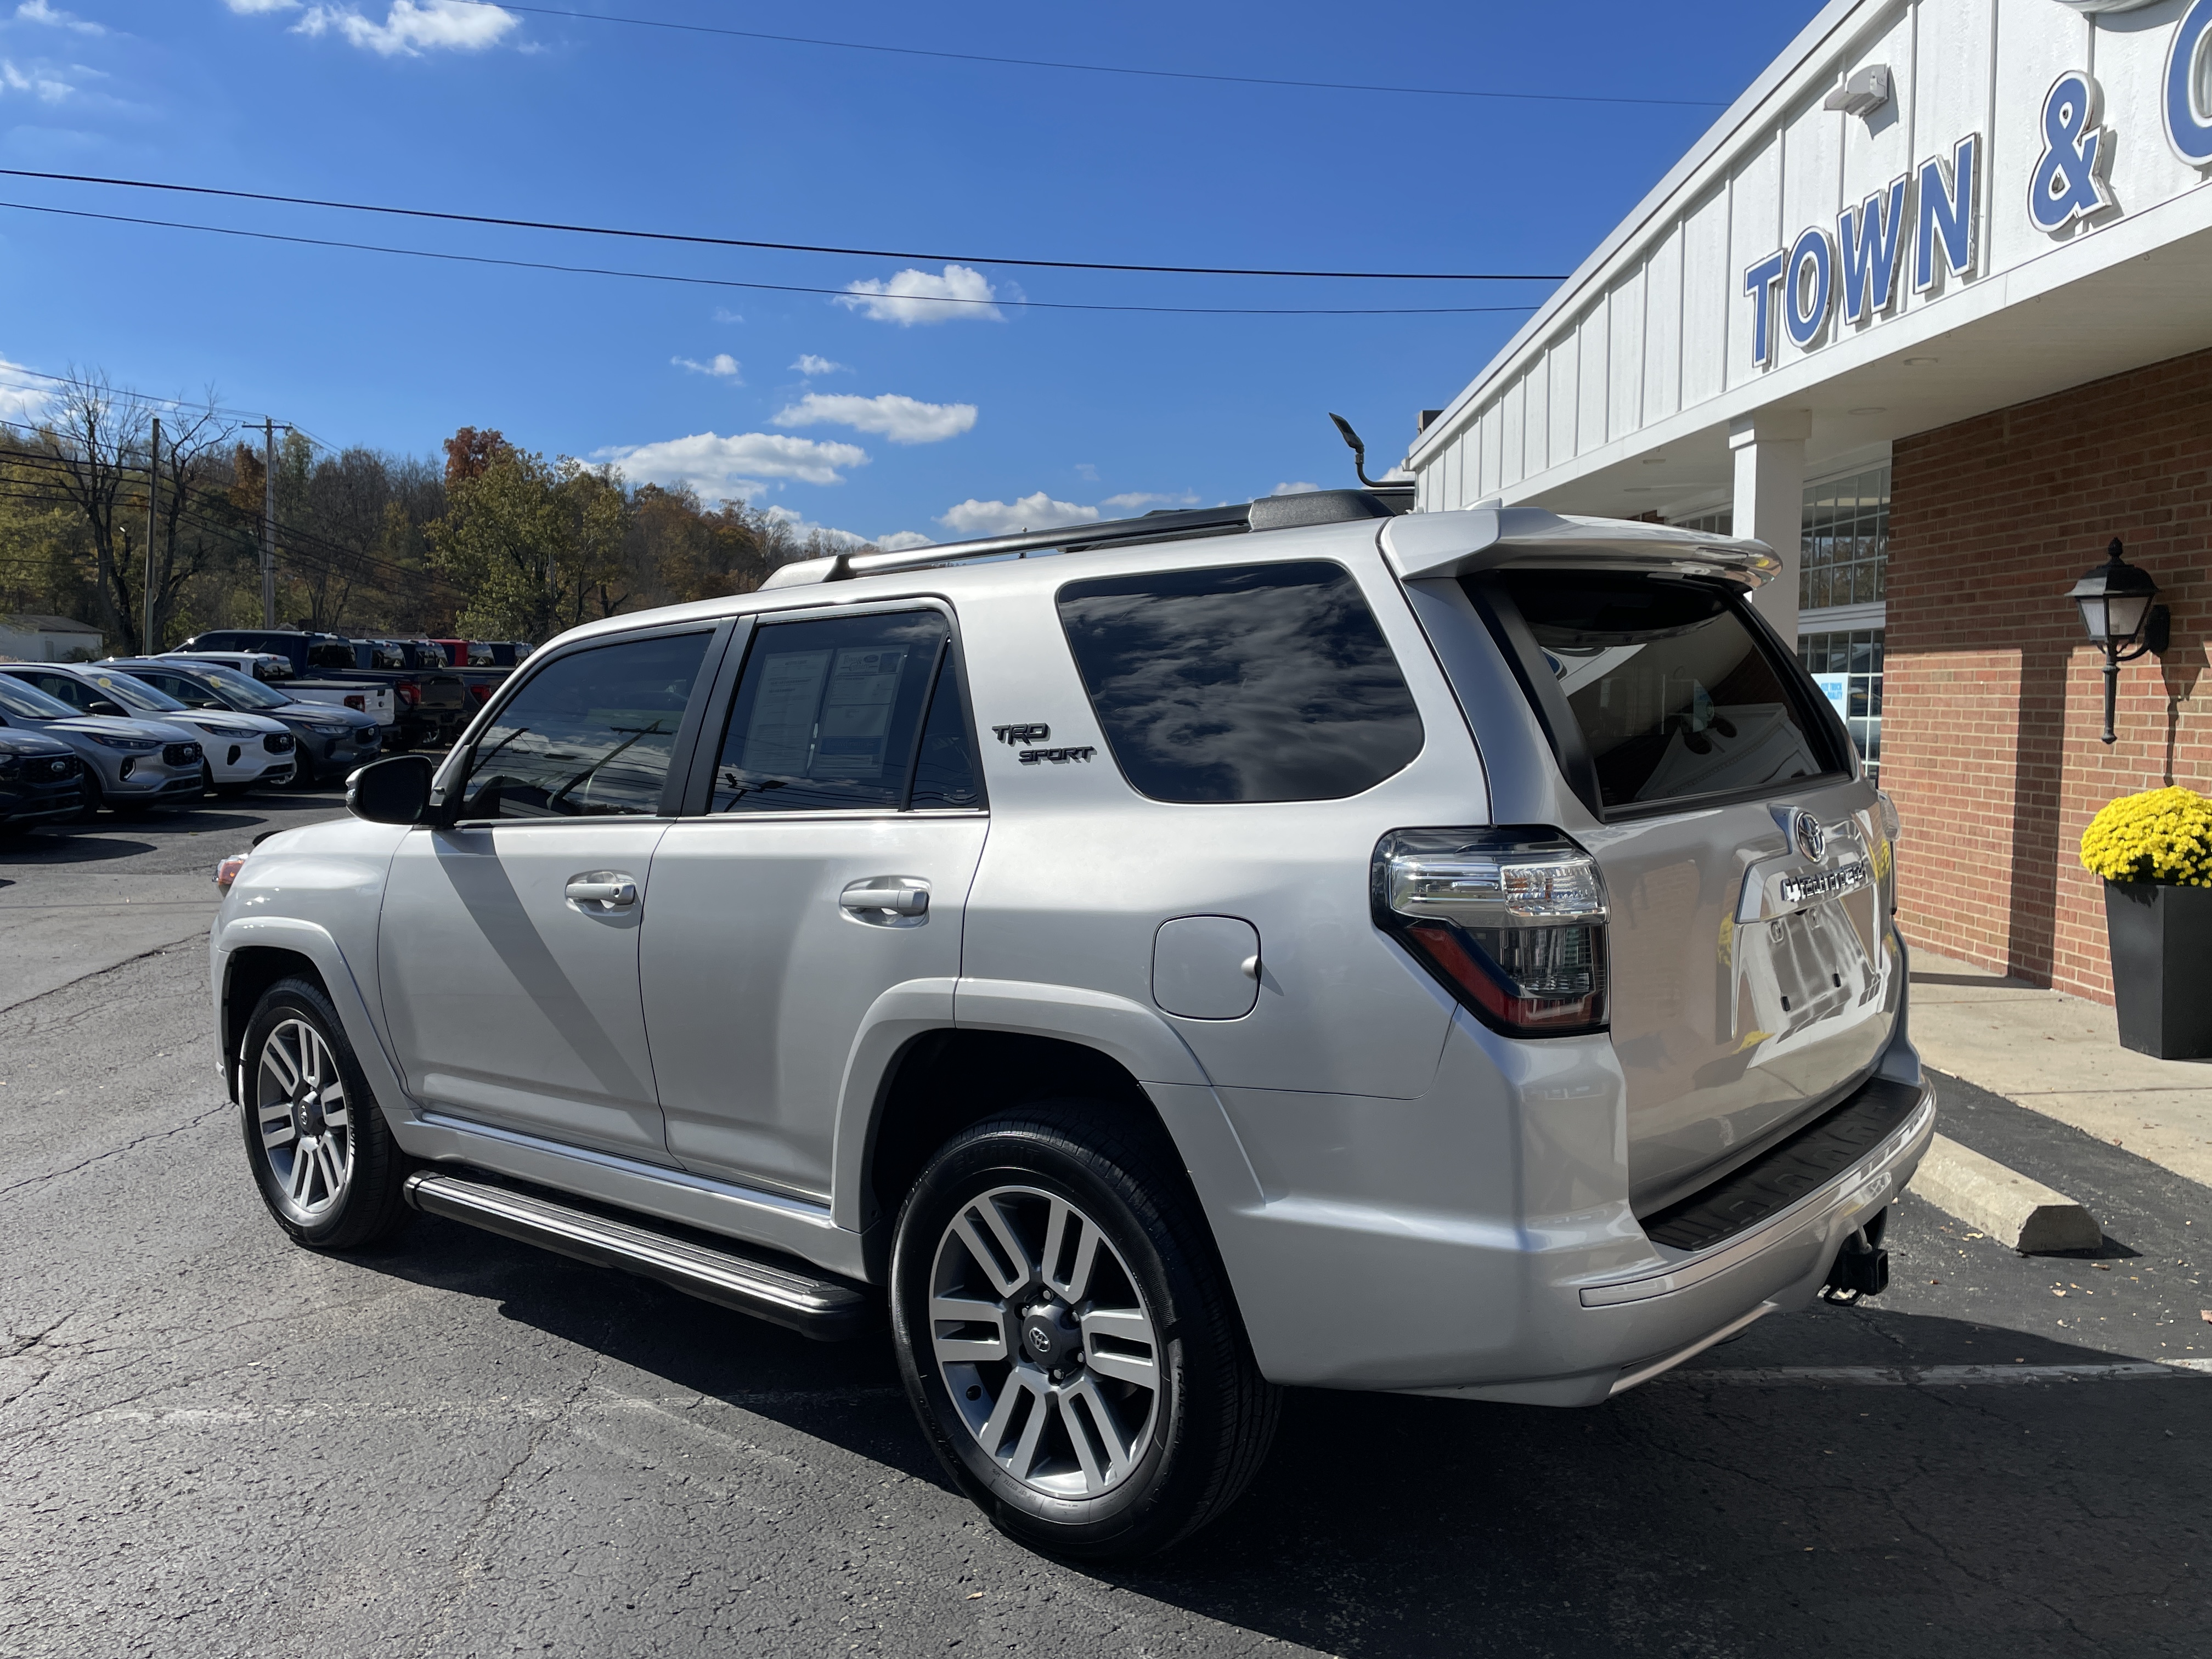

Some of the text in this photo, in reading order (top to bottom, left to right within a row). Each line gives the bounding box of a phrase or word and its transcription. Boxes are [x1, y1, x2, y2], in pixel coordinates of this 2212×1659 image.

[1744, 132, 1980, 368] TOWN
[2028, 70, 2113, 233] &
[992, 723, 1047, 745] TRD
[1019, 746, 1094, 763] SPORT
